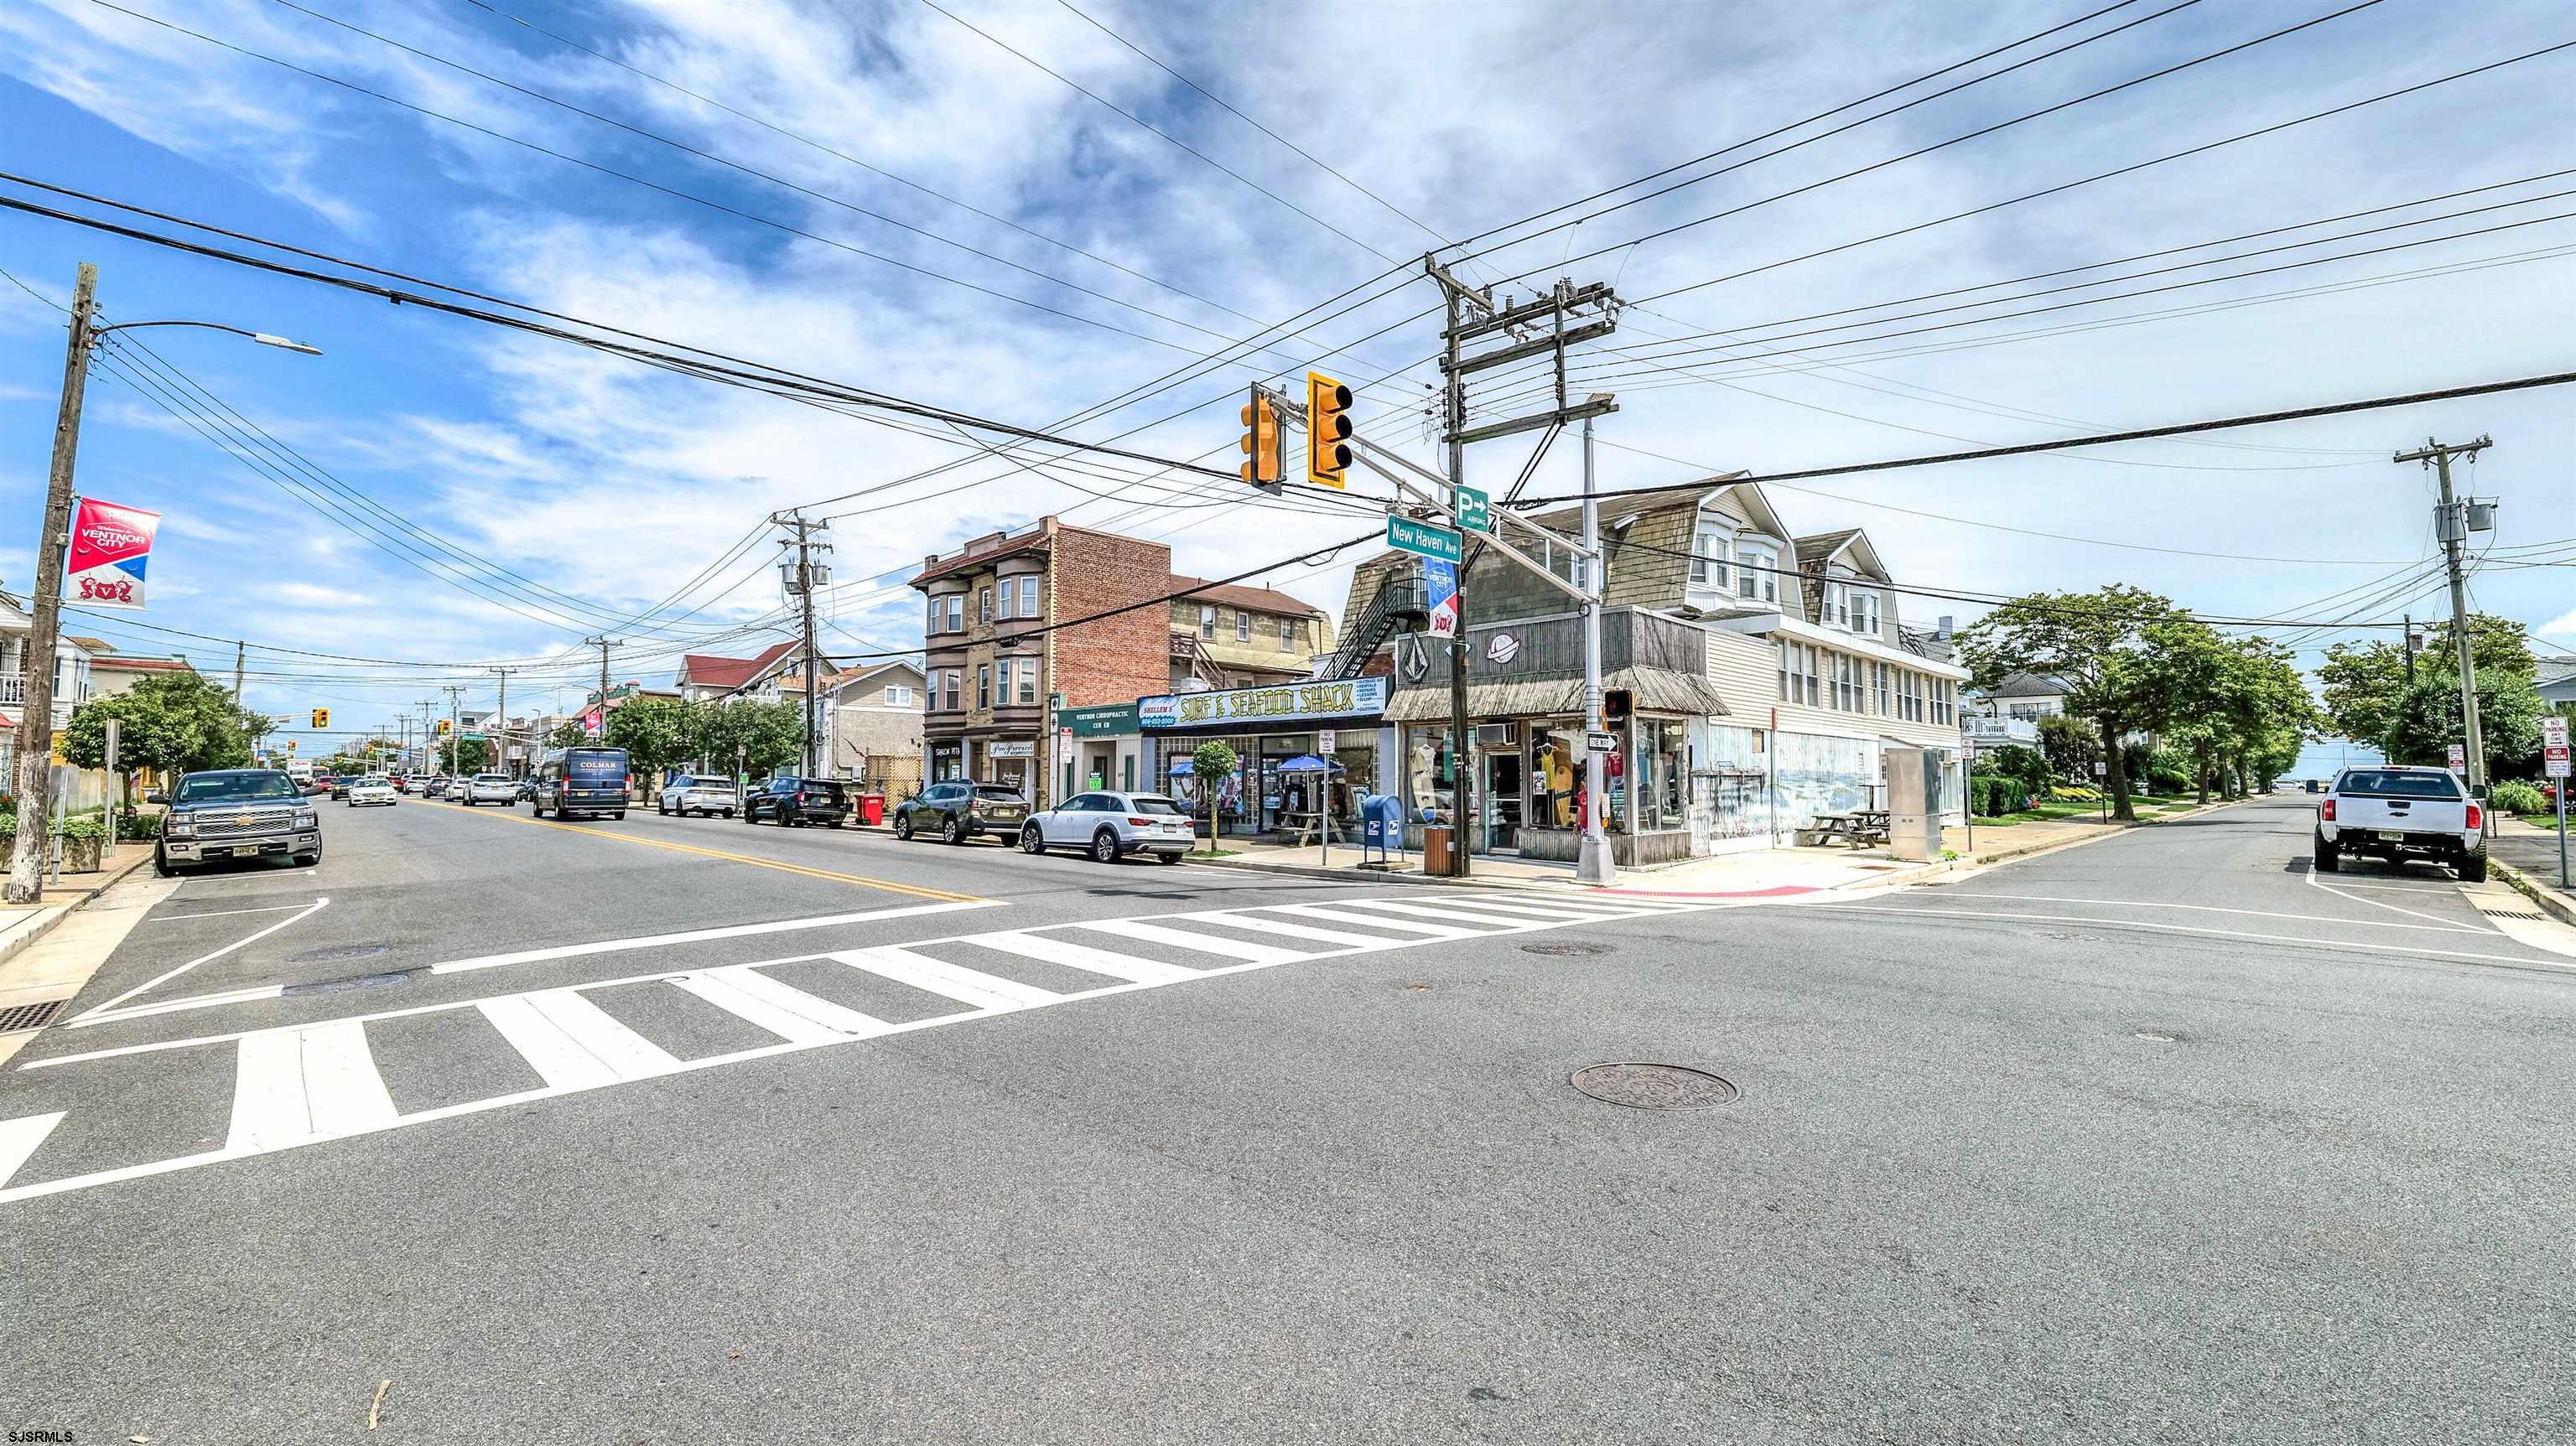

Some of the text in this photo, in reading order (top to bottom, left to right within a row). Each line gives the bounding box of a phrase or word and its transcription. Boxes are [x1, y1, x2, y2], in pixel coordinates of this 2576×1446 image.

[1458, 491, 1473, 520] P
[1467, 516, 1486, 526] ARKING
[81, 528, 146, 544] VENTNOR
[1393, 523, 1457, 555] New Haven Ave
[96, 538, 127, 548] CITY
[1428, 573, 1452, 584] VENTNOR
[1181, 696, 1212, 723] SURF
[1230, 689, 1295, 718] SEAFOOD
[1301, 683, 1354, 713] SHACK
[1076, 710, 1130, 721] VENTNOR CHIROPRACTIC
[1591, 738, 1609, 747] ONE WAY
